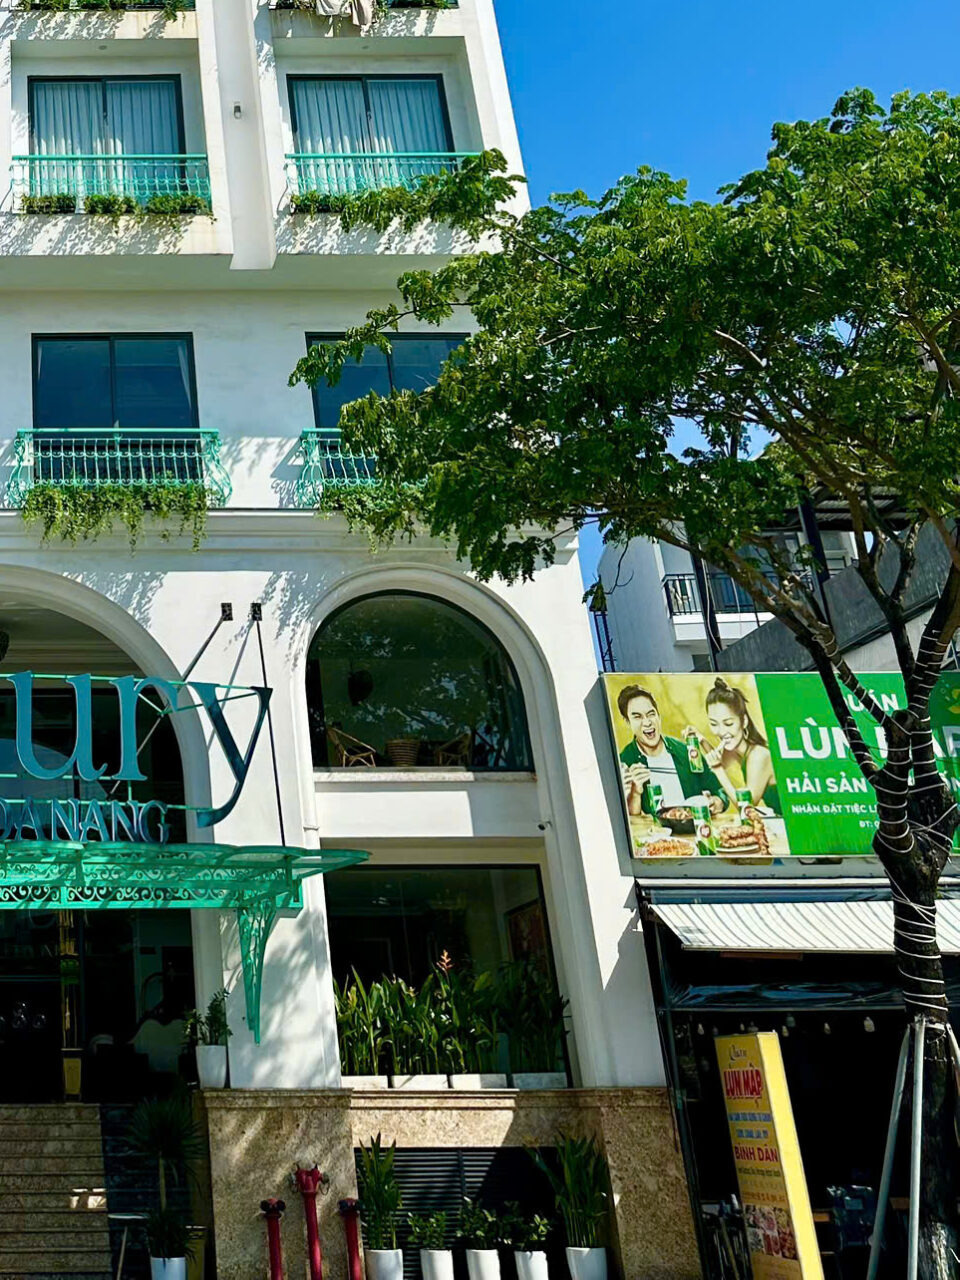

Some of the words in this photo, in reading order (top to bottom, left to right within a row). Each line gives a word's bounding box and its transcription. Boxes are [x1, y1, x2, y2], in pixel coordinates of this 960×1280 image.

[786, 771, 822, 793] HẢI
[825, 771, 869, 793] SẢN
[791, 803, 821, 815] NHẬN
